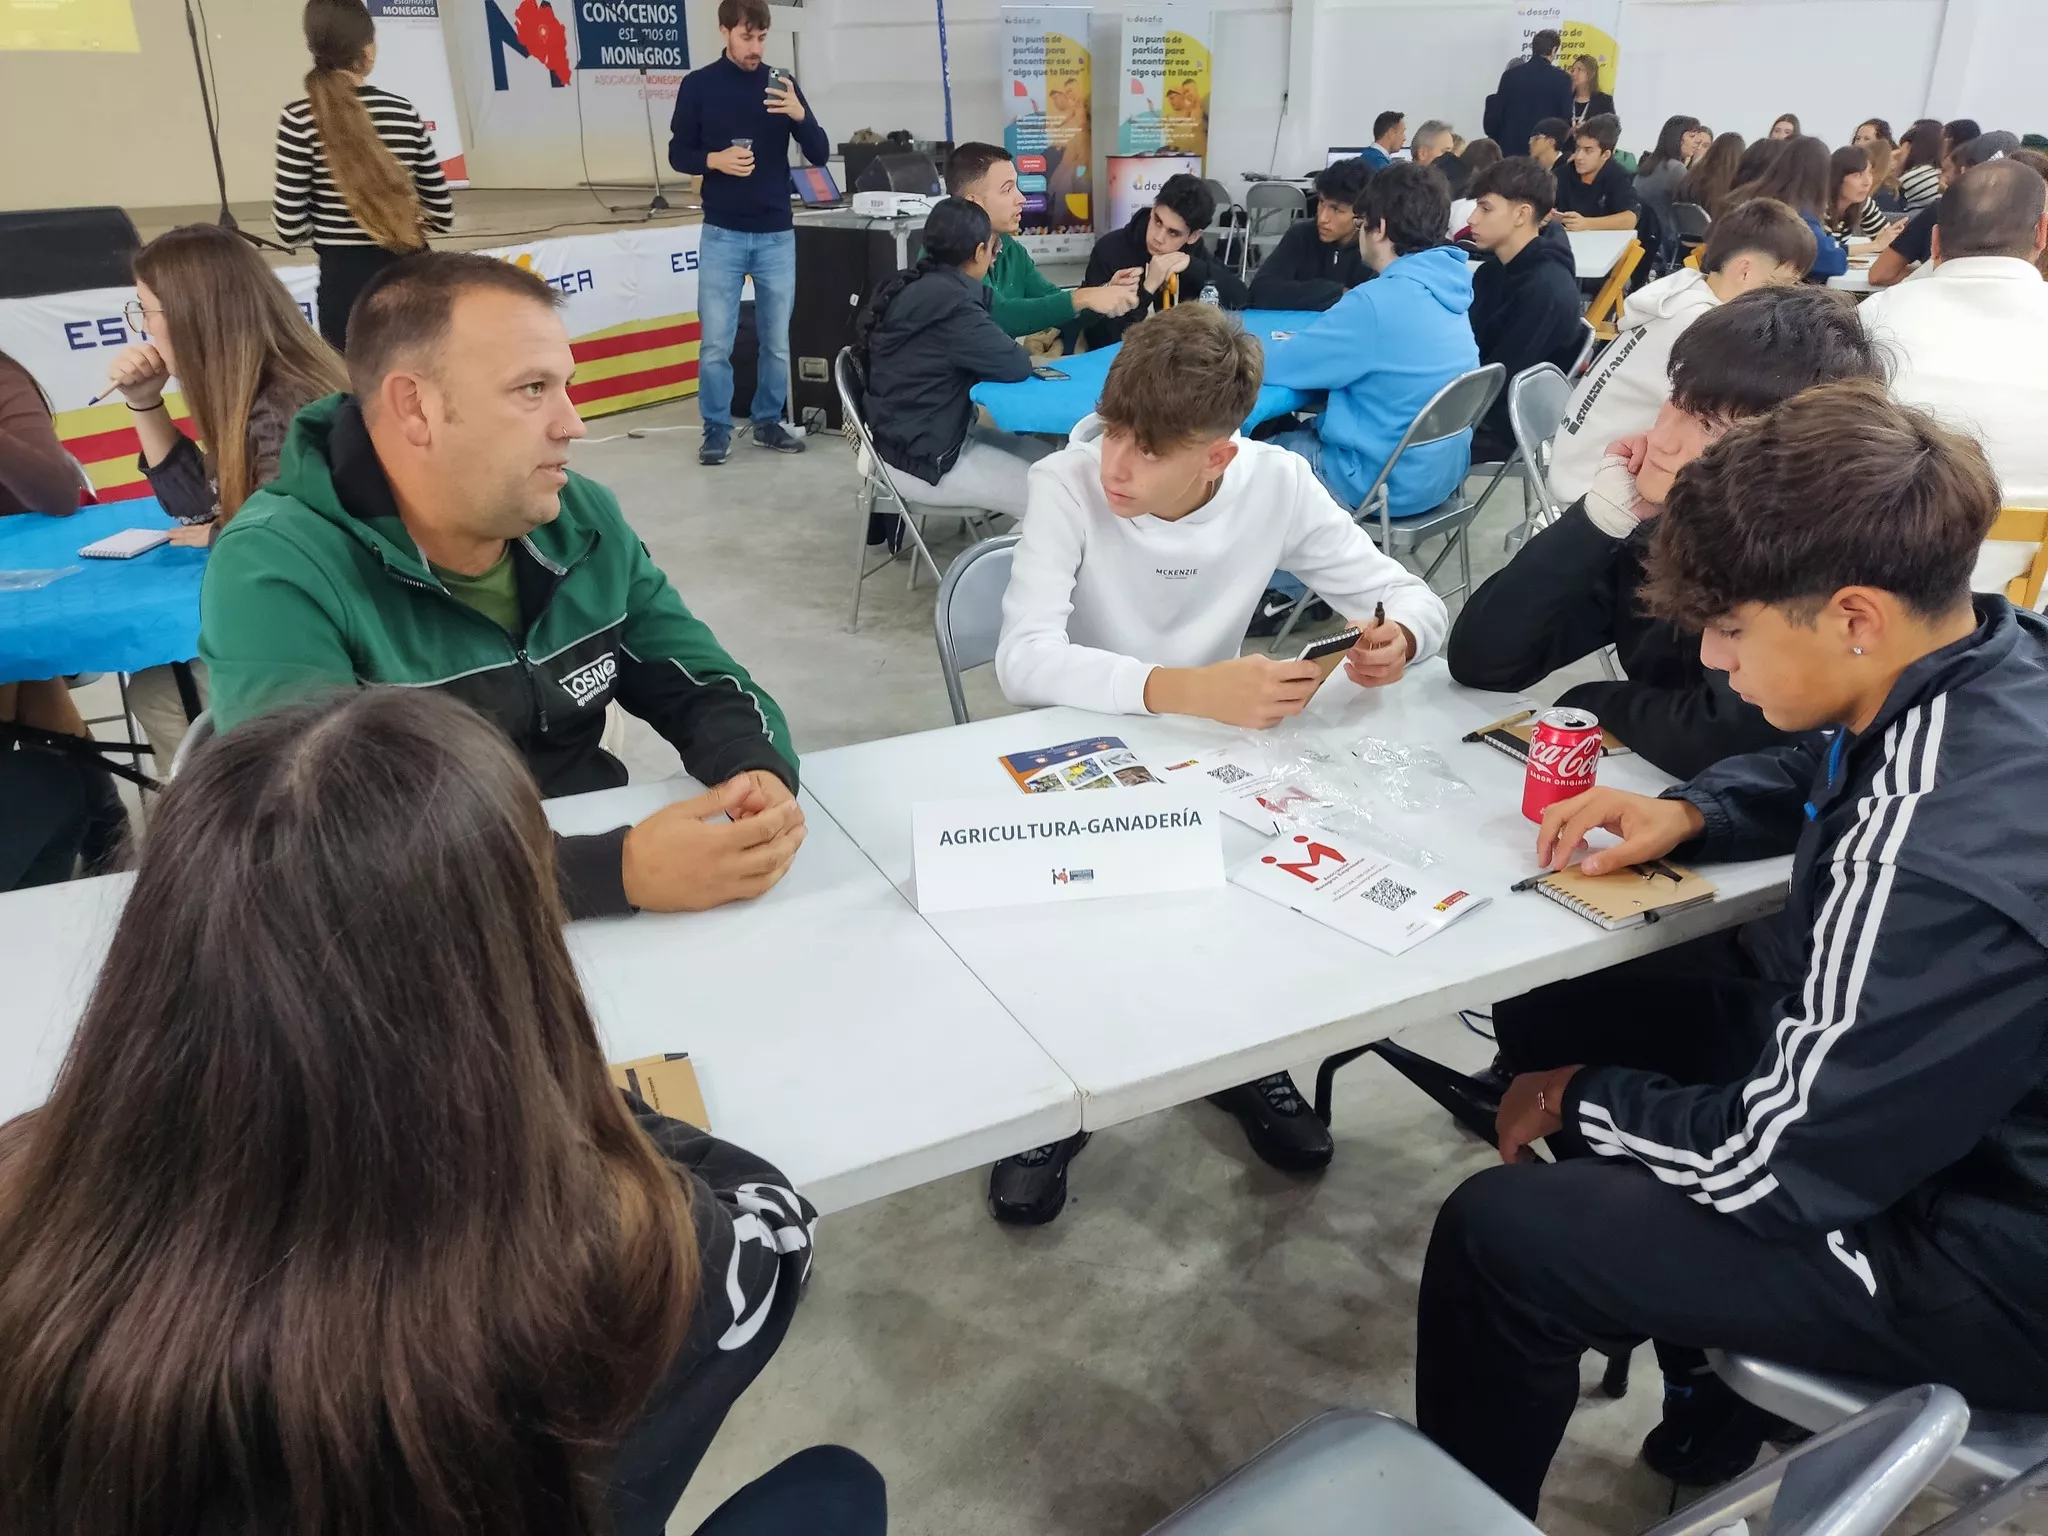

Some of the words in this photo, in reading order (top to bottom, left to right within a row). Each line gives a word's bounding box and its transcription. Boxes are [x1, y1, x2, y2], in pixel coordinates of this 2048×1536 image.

[382, 6, 436, 16] MONEGROS
[618, 27, 663, 41] estmos
[665, 28, 678, 41] en
[1025, 36, 1050, 45] punto
[1145, 36, 1170, 45] punto
[1561, 41, 1586, 51] para
[1013, 46, 1045, 57] partida
[1045, 47, 1066, 57] para
[1132, 46, 1164, 56] partida
[1165, 47, 1185, 57] para
[1033, 69, 1048, 78] que
[1049, 68, 1058, 76] te
[1151, 69, 1166, 78] que
[1168, 68, 1177, 76] te
[645, 75, 683, 85] MONEGRO
[1529, 769, 1552, 785] SABOR
[1554, 778, 1591, 787] ORIGINAL
[938, 807, 1203, 847] AGRICULTURA-GANADERÍA
